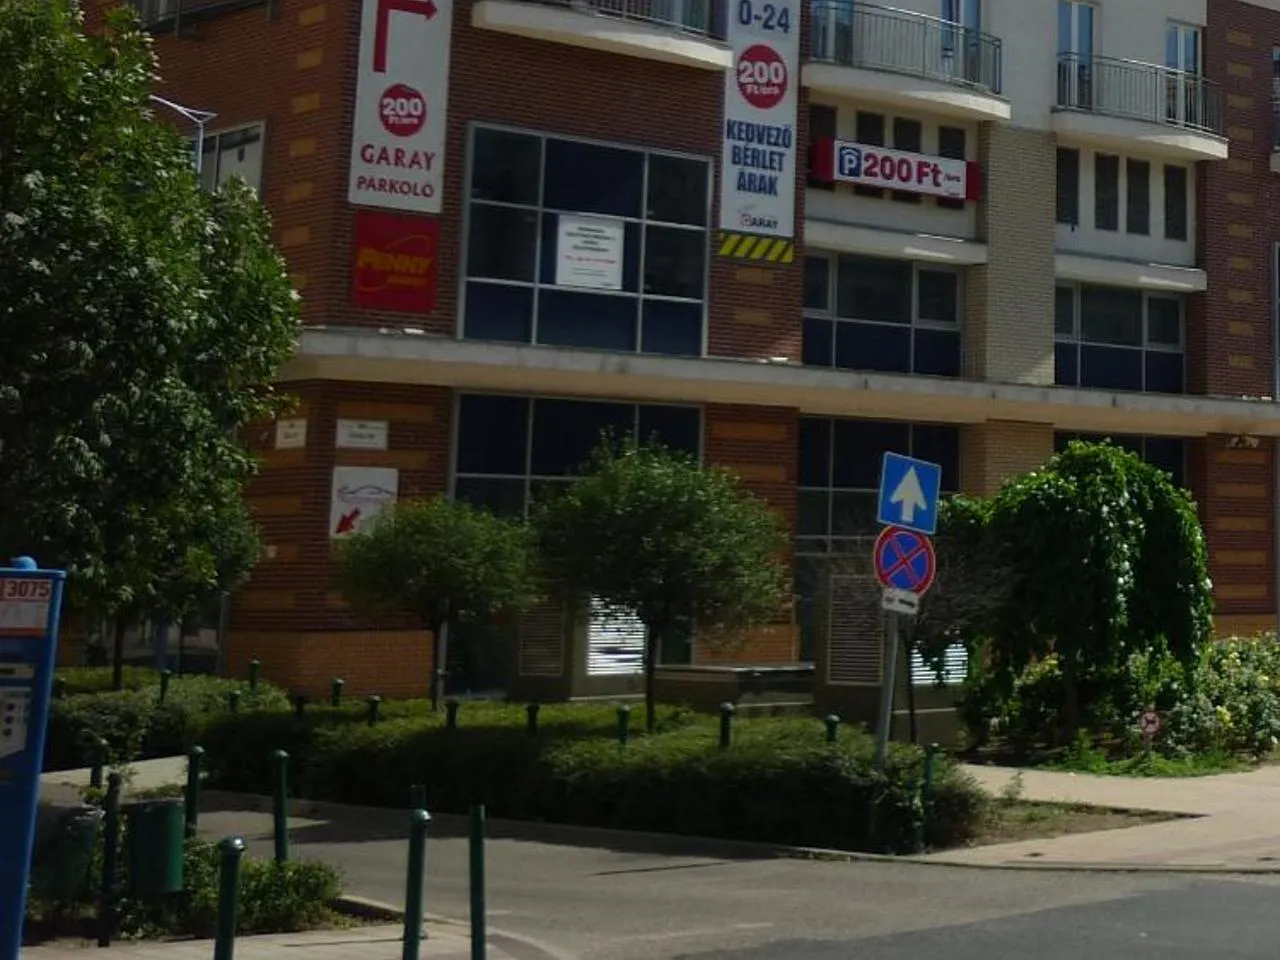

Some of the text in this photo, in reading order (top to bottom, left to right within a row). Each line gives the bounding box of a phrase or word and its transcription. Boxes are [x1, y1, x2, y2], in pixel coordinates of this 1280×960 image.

[739, 60, 785, 84] 200
[381, 97, 424, 116] 200
[360, 143, 437, 172] GARAY
[863, 152, 943, 188] 200 Ft
[7, 580, 49, 598] 3075
